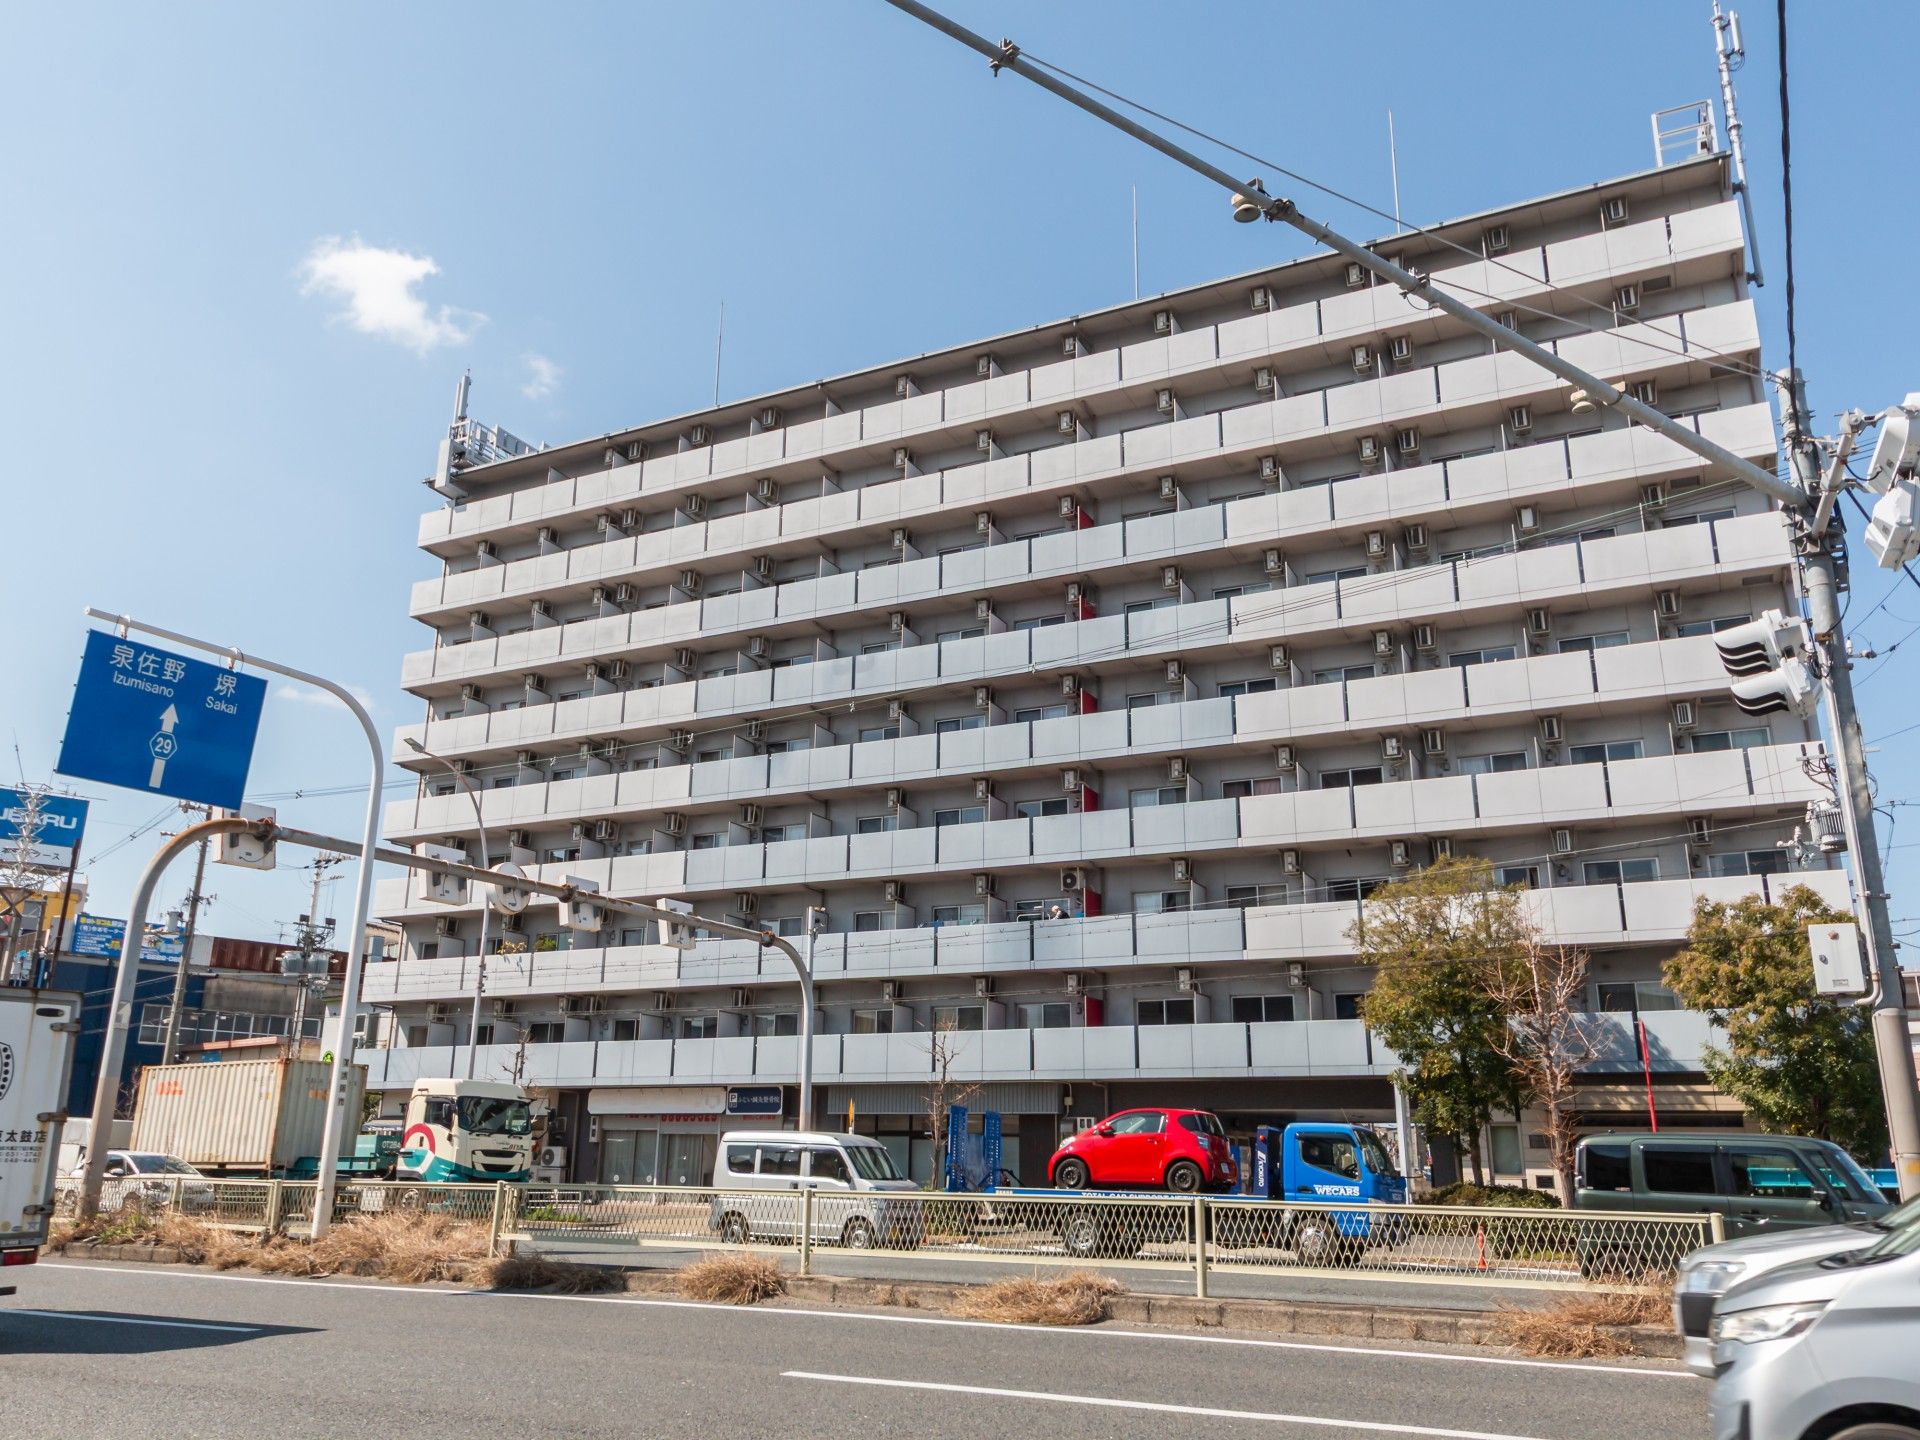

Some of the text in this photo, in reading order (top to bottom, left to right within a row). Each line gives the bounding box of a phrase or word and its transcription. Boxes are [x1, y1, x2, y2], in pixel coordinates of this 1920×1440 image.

[109, 644, 187, 683] 泉佐野
[113, 670, 174, 698] Izumisano
[214, 673, 237, 697] 堺
[205, 696, 238, 715] Sakai
[155, 738, 172, 753] 29
[1315, 1186, 1360, 1197] WECARS
